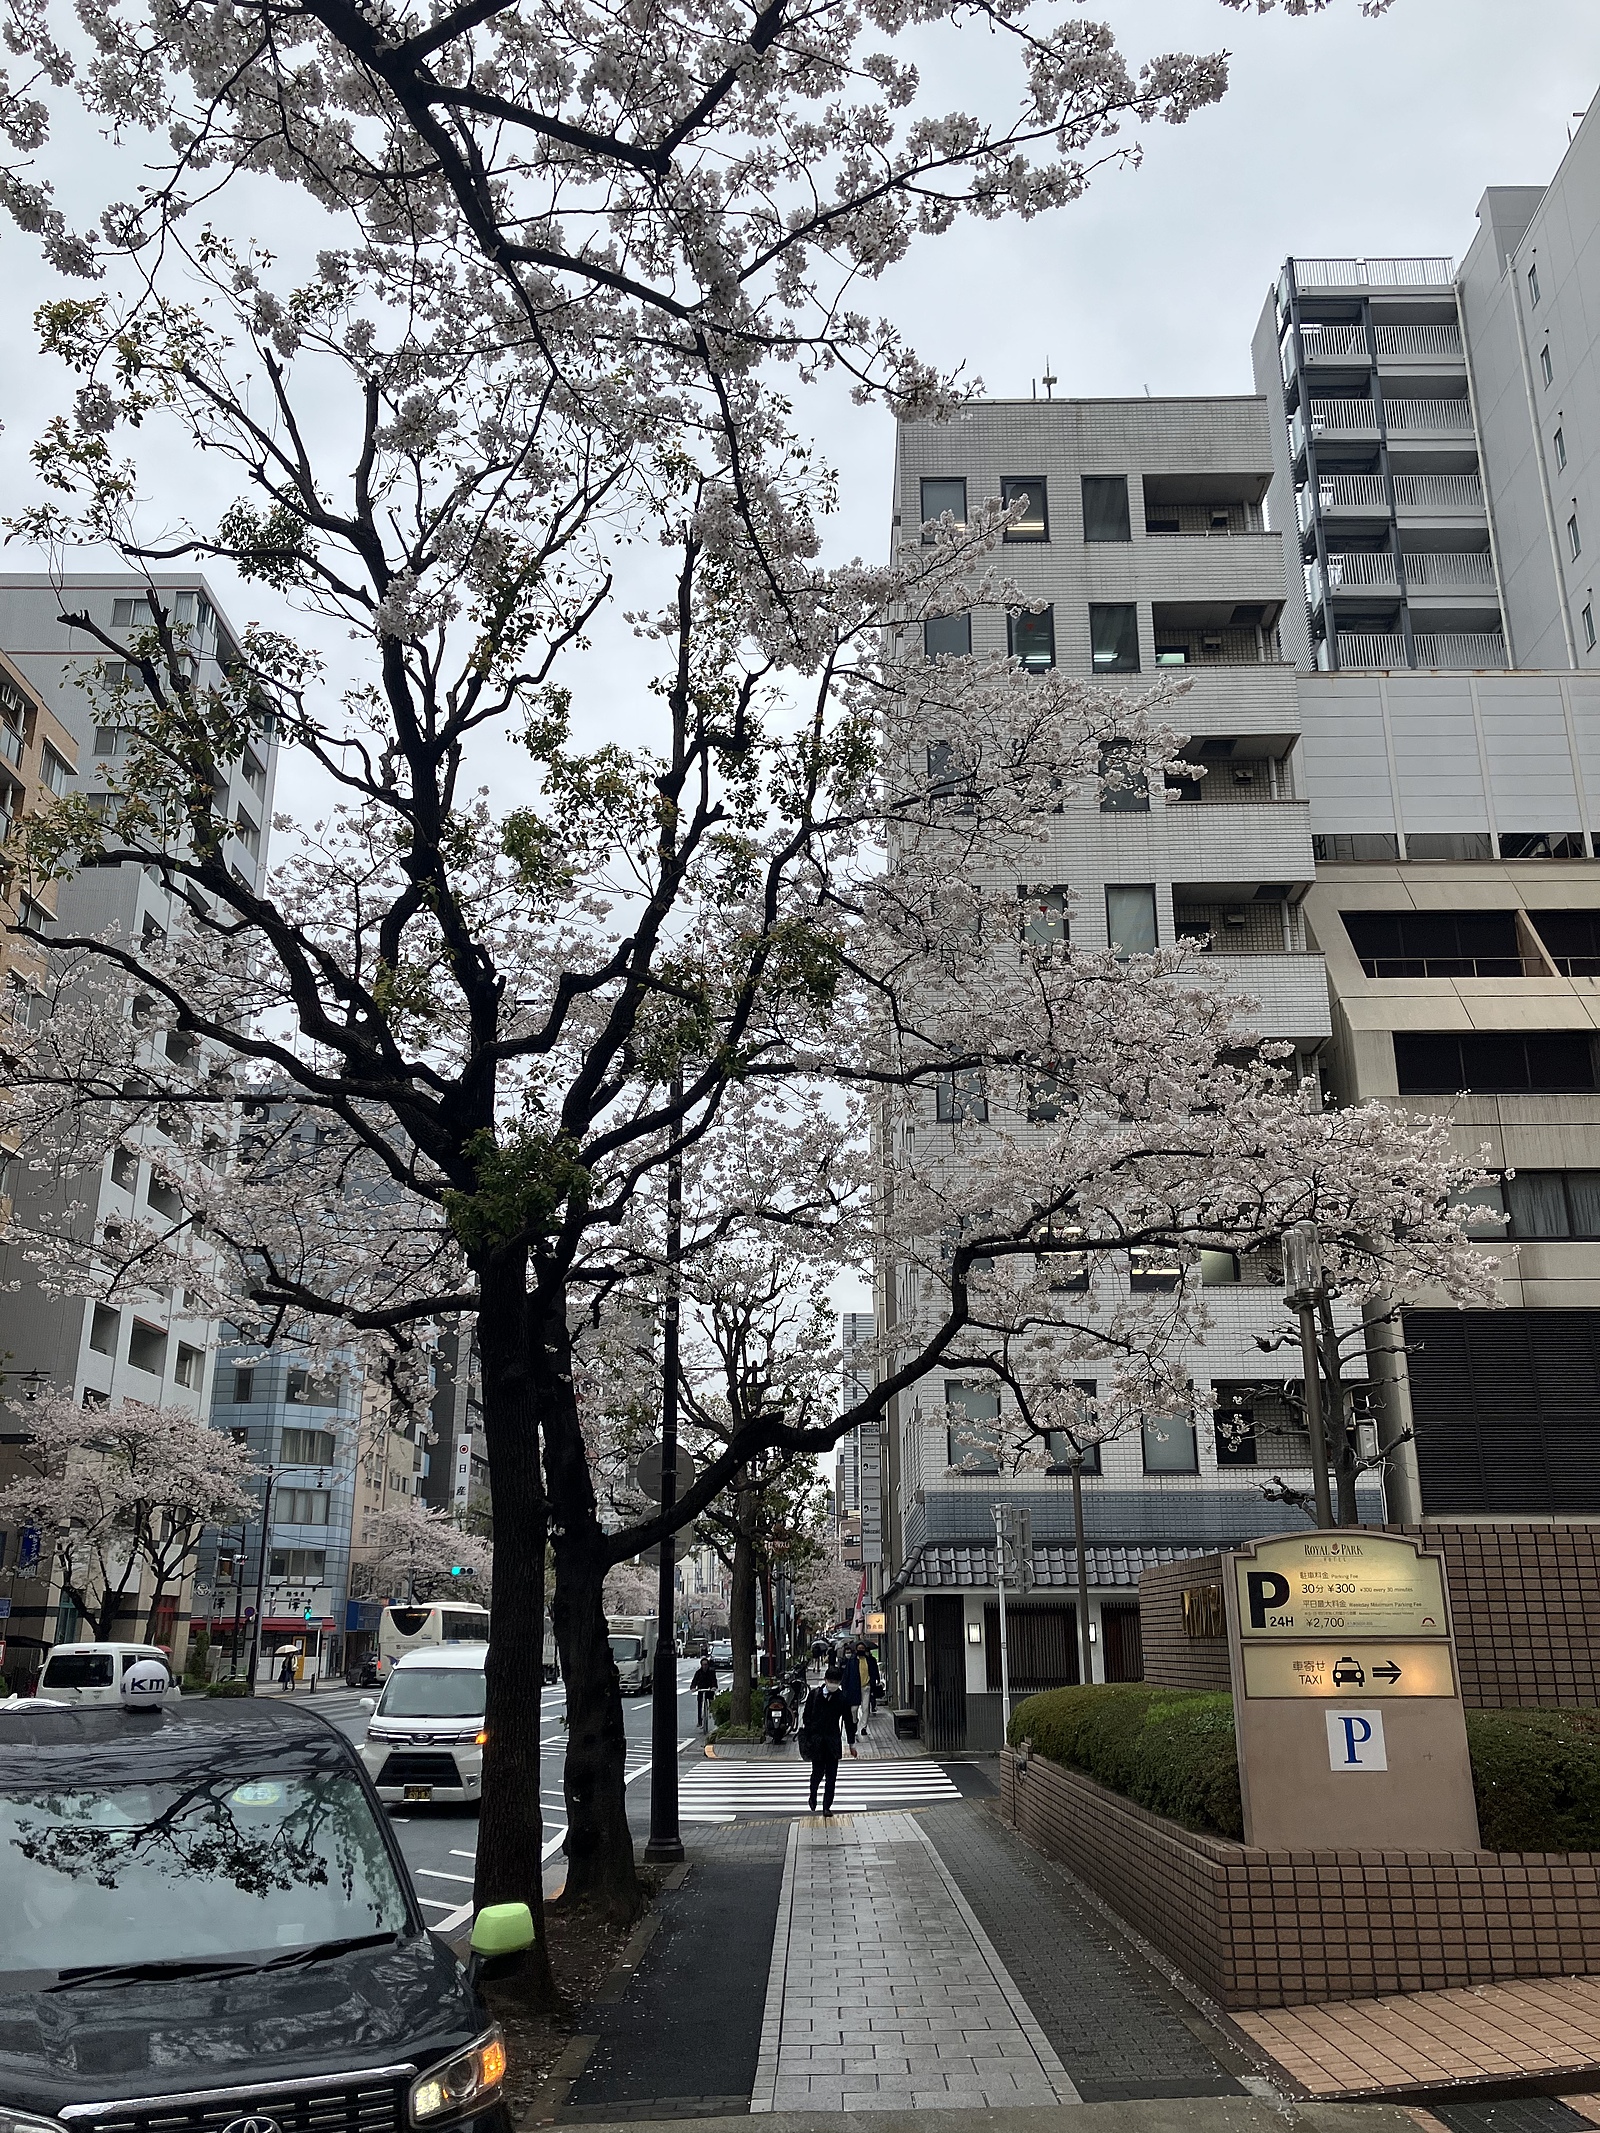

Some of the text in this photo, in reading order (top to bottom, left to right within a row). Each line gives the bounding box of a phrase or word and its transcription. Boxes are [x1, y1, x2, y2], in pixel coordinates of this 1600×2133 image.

[1304, 1544, 1364, 1556] ROYAL PARK
[1300, 1571, 1330, 1580] 駐車料金
[1301, 1583, 1356, 1594] 30分 ¥300
[1246, 1571, 1291, 1629] P
[1302, 1600, 1347, 1609] 平日最大料金
[1269, 1616, 1294, 1627] 24H
[1306, 1617, 1345, 1629] ¥2,700
[1292, 1660, 1326, 1672] 車寄せ
[1298, 1674, 1323, 1685] TAXI
[1337, 1716, 1372, 1764] P
